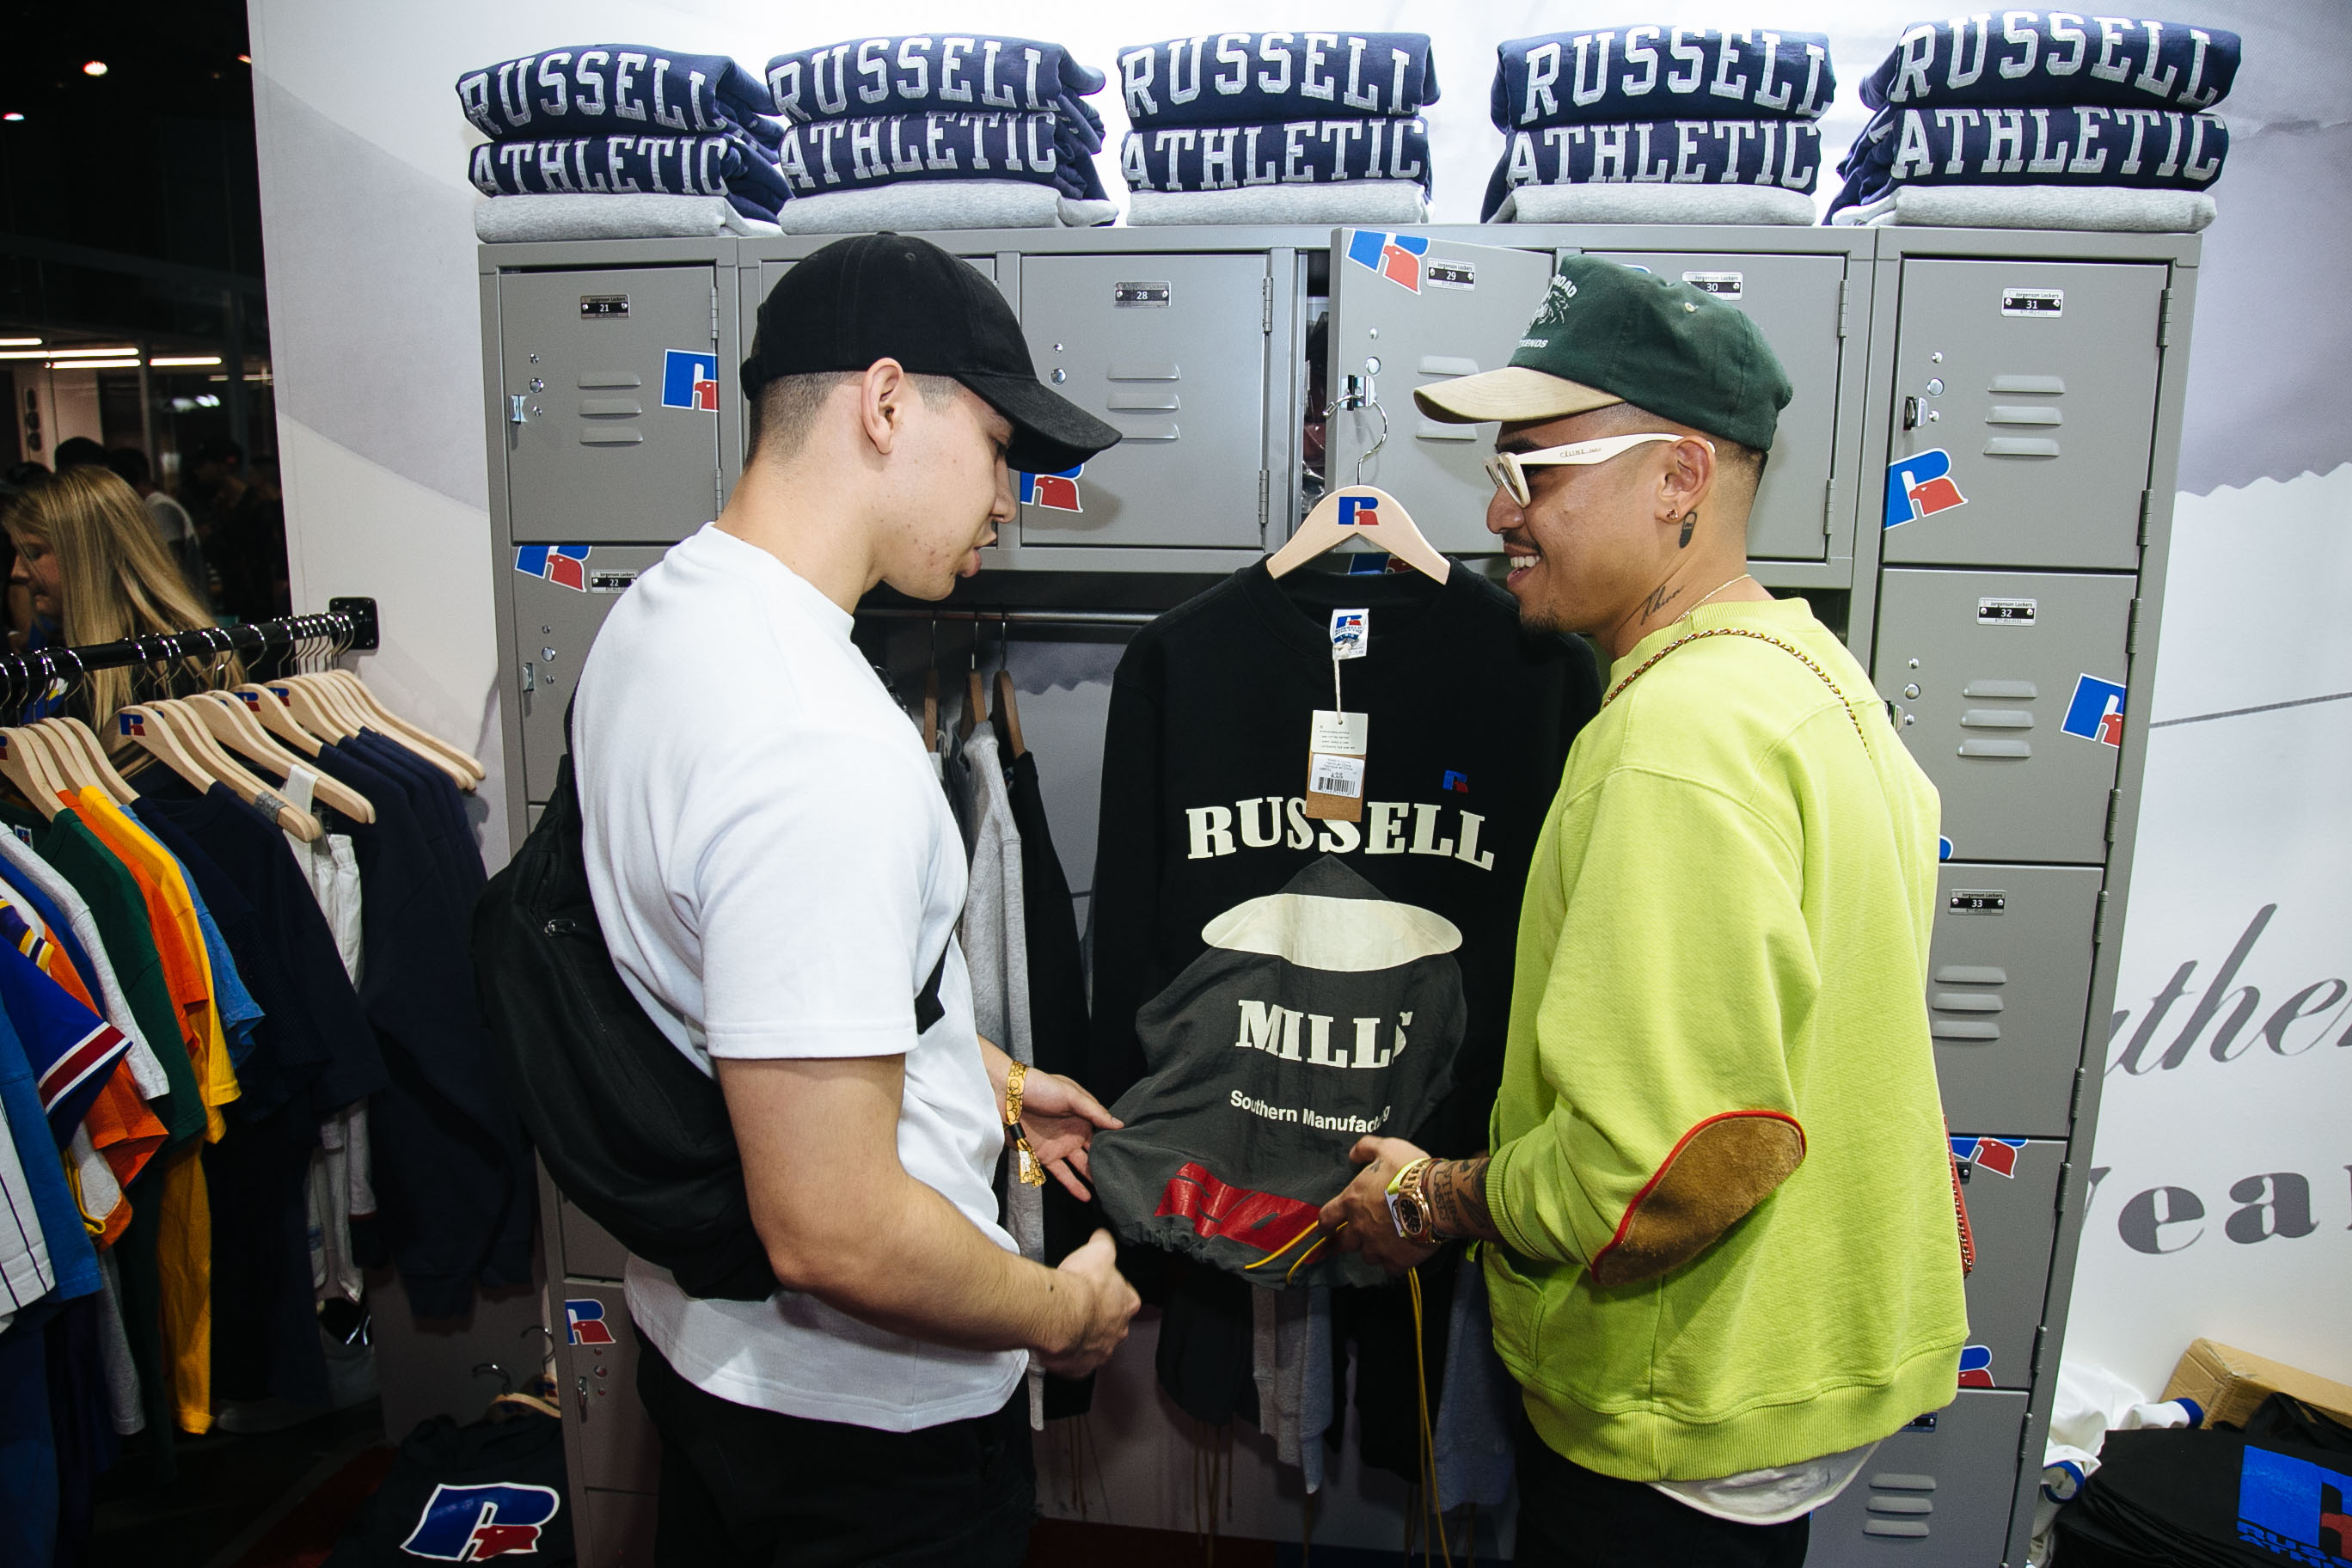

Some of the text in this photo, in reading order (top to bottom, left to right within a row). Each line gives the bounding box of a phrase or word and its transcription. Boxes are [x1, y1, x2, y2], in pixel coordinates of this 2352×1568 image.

[460, 51, 728, 135] RUSSELL
[769, 37, 1061, 124] RUSSELL
[1122, 32, 1423, 118] RUSSELL
[1521, 26, 1832, 125] RUSSELL
[1890, 11, 2218, 107] RUSSELL
[474, 133, 729, 197] ATHLETIC
[780, 111, 1057, 190] ATHLETIC
[1121, 117, 1424, 191] ATHLETIC
[1507, 120, 1817, 189] ATHLETIC
[1890, 106, 2226, 181] ATHLETIC
[599, 303, 609, 312] 21
[1136, 291, 1148, 300] 28
[1446, 271, 1457, 281] 29
[1706, 283, 1718, 292] 30
[2025, 300, 2038, 309] 31
[609, 579, 619, 587] 22
[2000, 609, 2012, 618] 32
[1185, 796, 1495, 871] RUSSELL
[1971, 899, 1983, 908] 33
[2104, 903, 2352, 1076] the
[1230, 1089, 1298, 1123] Southern
[2081, 1165, 2352, 1254] ea
